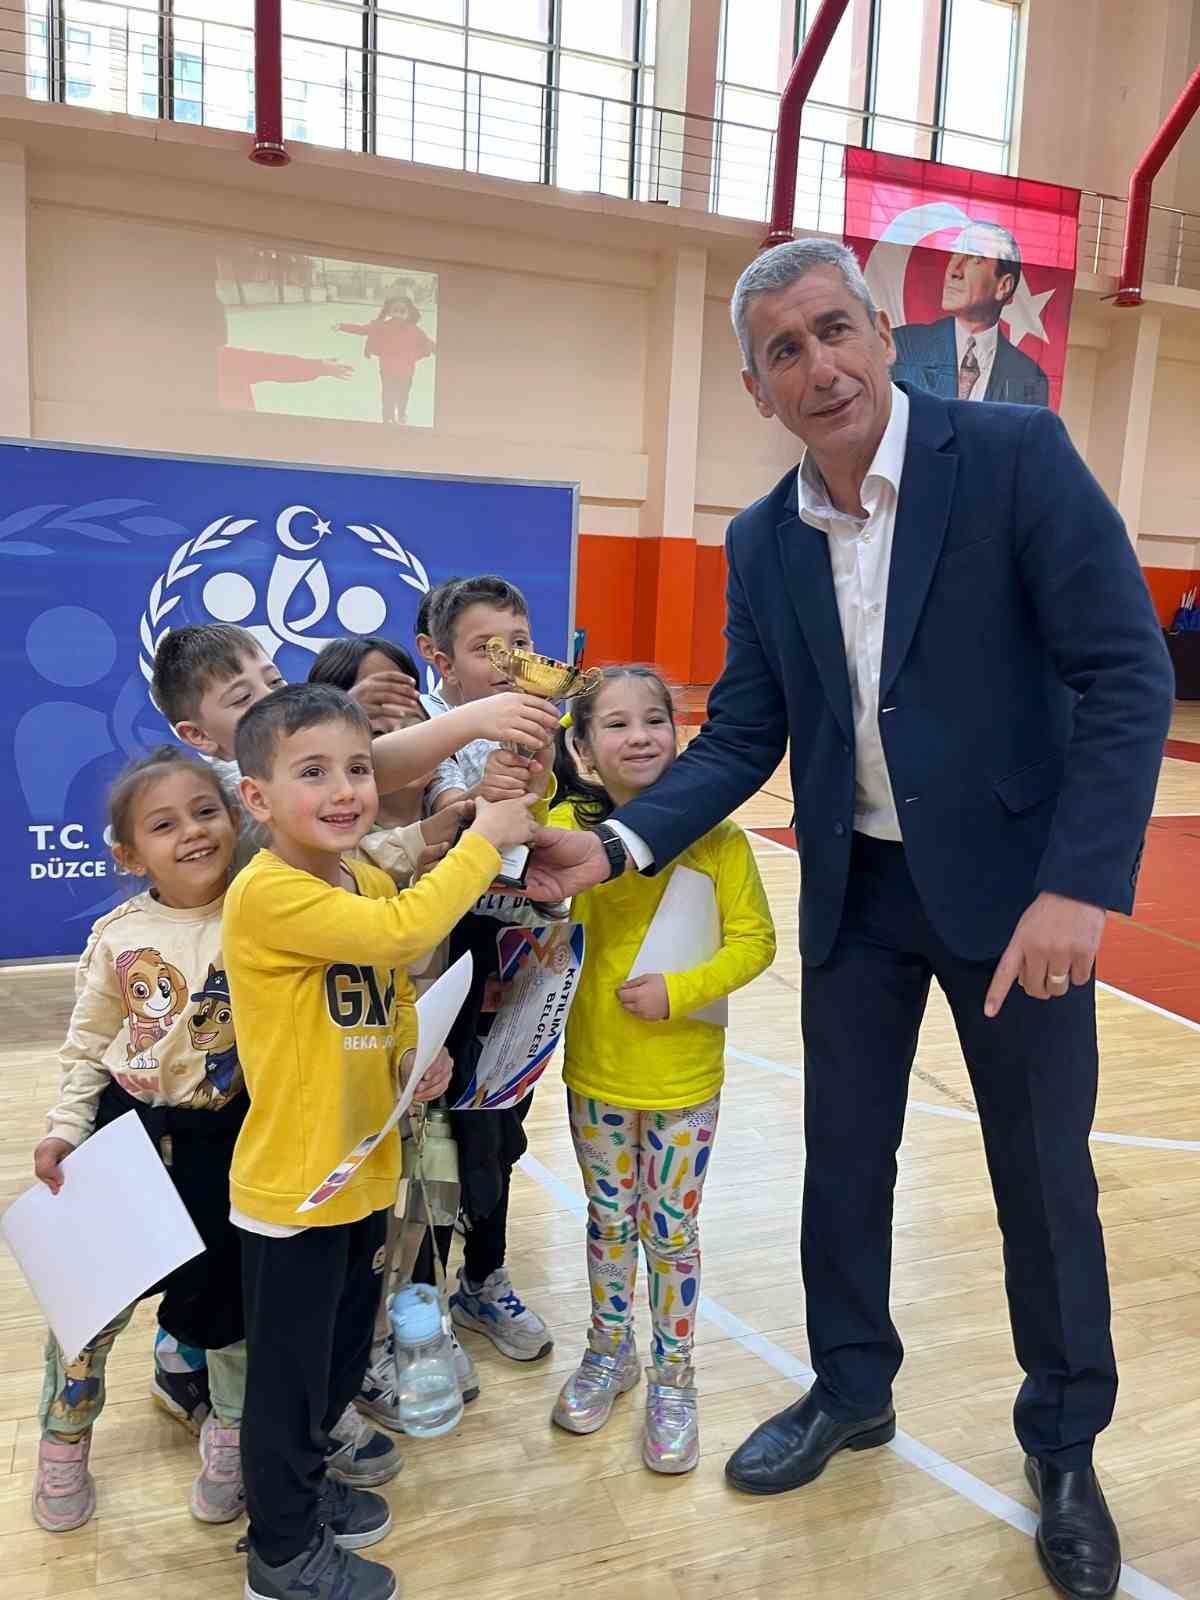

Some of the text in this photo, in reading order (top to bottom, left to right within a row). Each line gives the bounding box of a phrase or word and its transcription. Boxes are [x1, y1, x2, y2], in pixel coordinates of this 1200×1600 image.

[29, 824, 90, 850] T.C.
[31, 857, 106, 880] DÜZCE
[548, 968, 576, 1037] KATILIM
